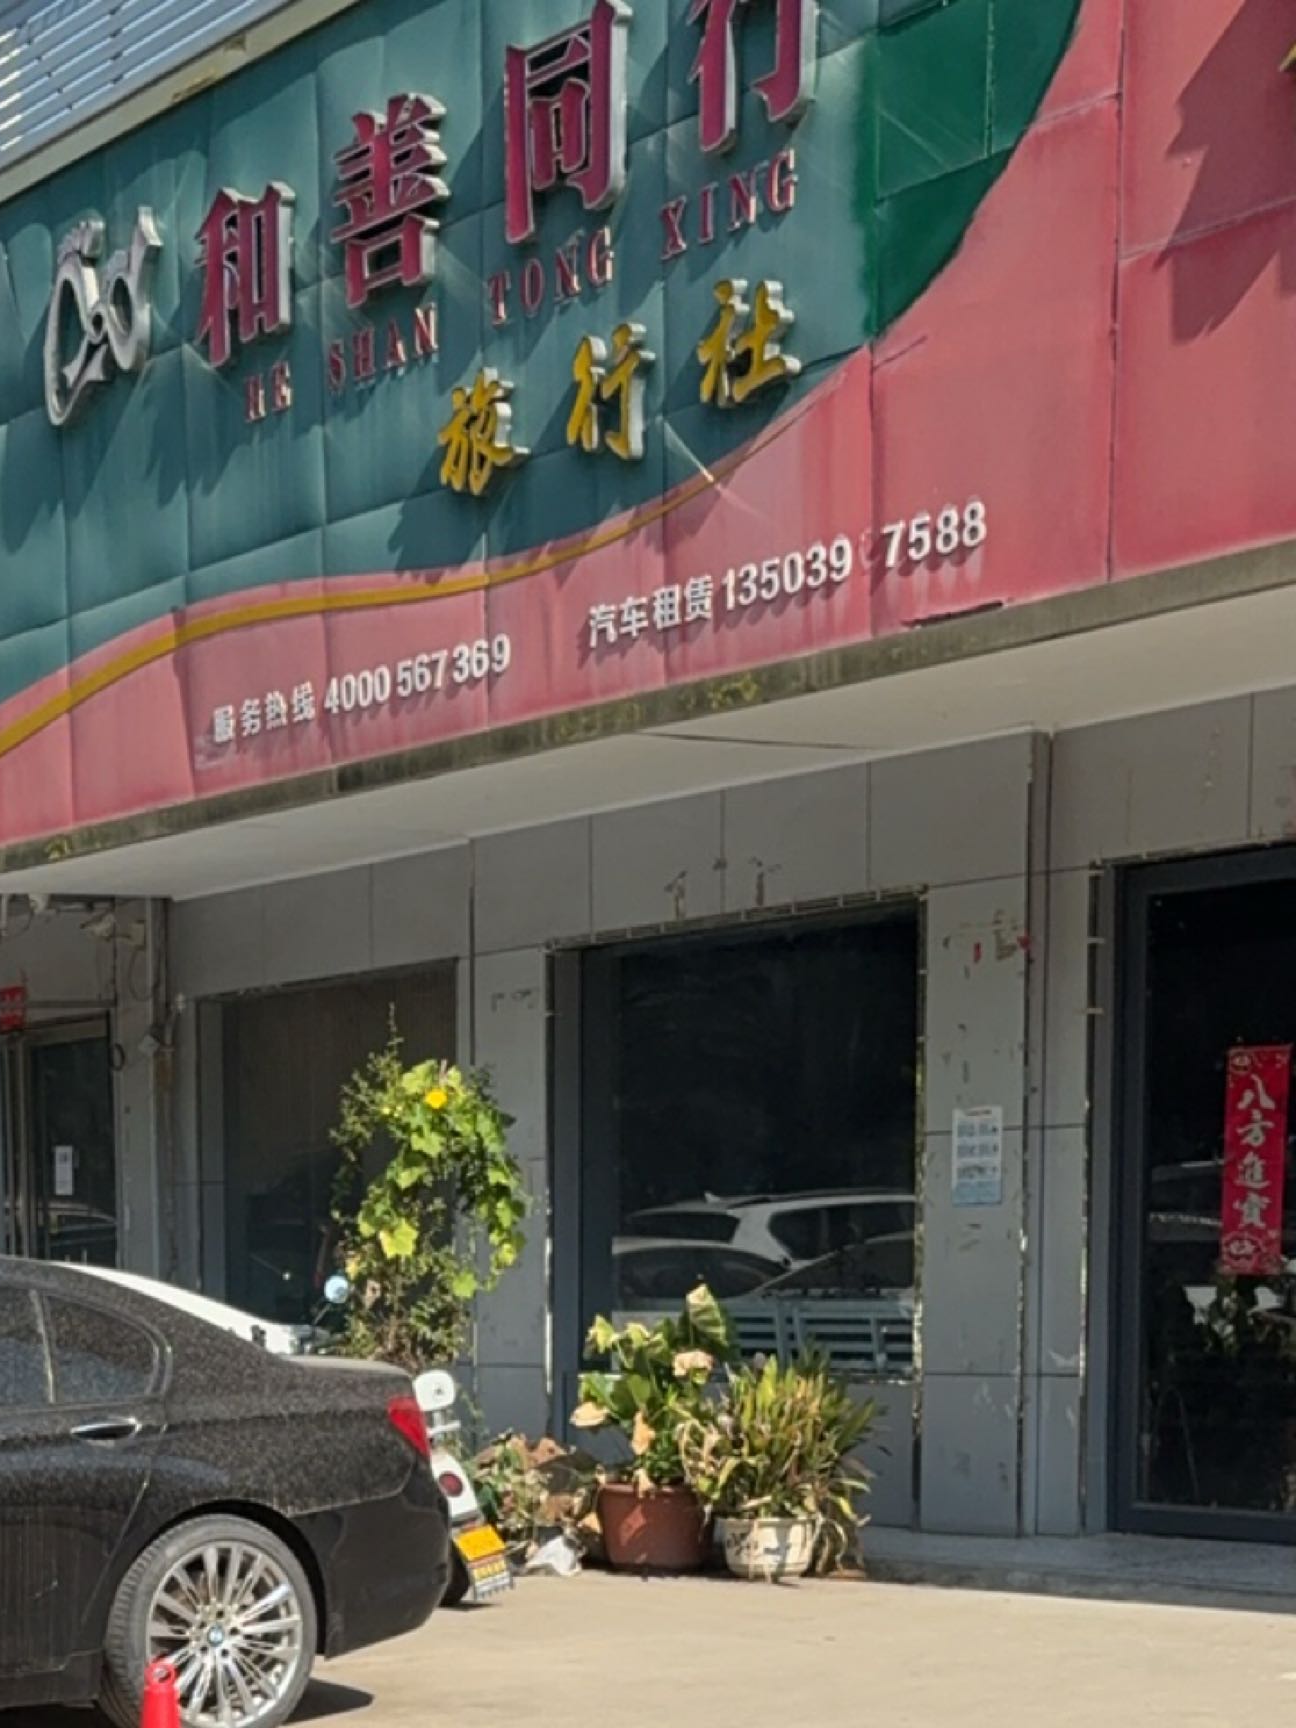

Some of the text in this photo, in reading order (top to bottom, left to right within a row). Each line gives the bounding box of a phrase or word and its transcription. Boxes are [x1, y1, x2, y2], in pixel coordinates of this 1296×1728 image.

[194, 0, 817, 367] 和善同行
[245, 148, 798, 422] HE SHAN TONG XING
[439, 278, 802, 496] 旅行社
[213, 681, 316, 743] 服务热线
[589, 575, 713, 648] 汽车租赁
